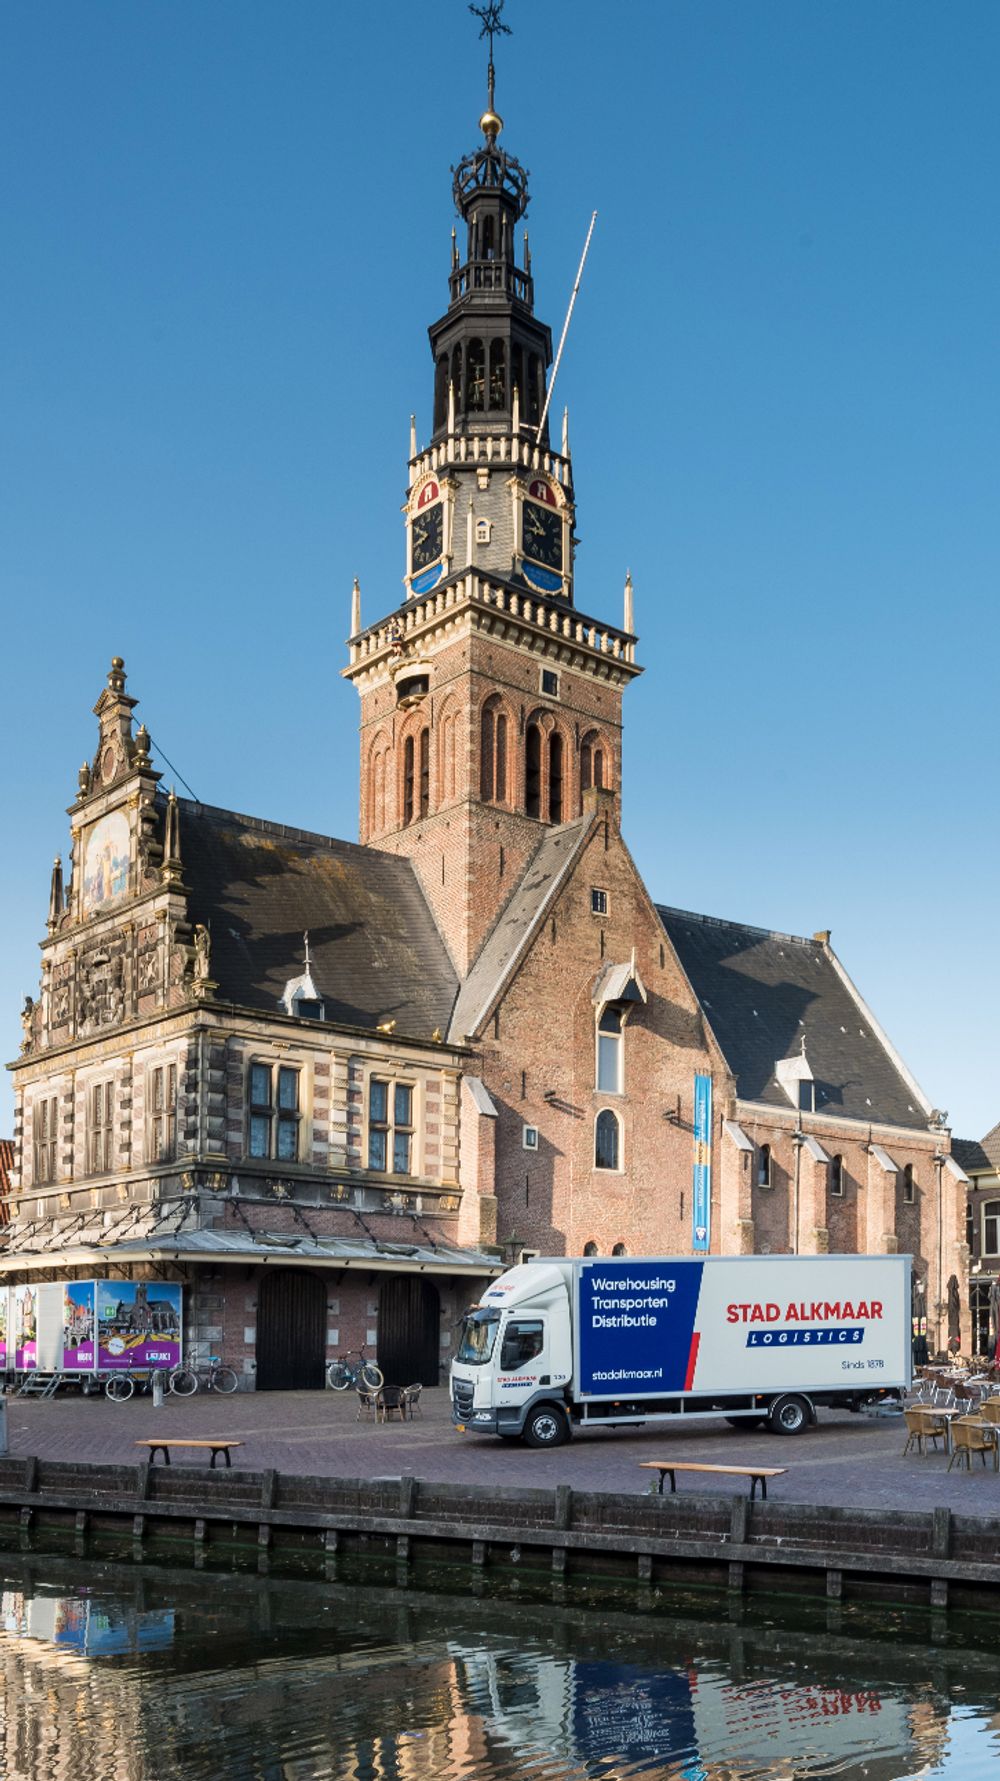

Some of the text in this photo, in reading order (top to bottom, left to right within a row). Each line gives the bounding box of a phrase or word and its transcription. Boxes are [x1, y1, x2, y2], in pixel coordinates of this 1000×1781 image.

[591, 1277, 676, 1292] Warehousing
[591, 1296, 668, 1311] Transporten
[726, 1301, 883, 1323] STAD ALKMAAR
[592, 1314, 657, 1328] Distributie
[750, 1330, 860, 1344] LOGISTICS
[841, 1360, 864, 1369] Sinds
[592, 1368, 663, 1380] stadalkmaar.nl
